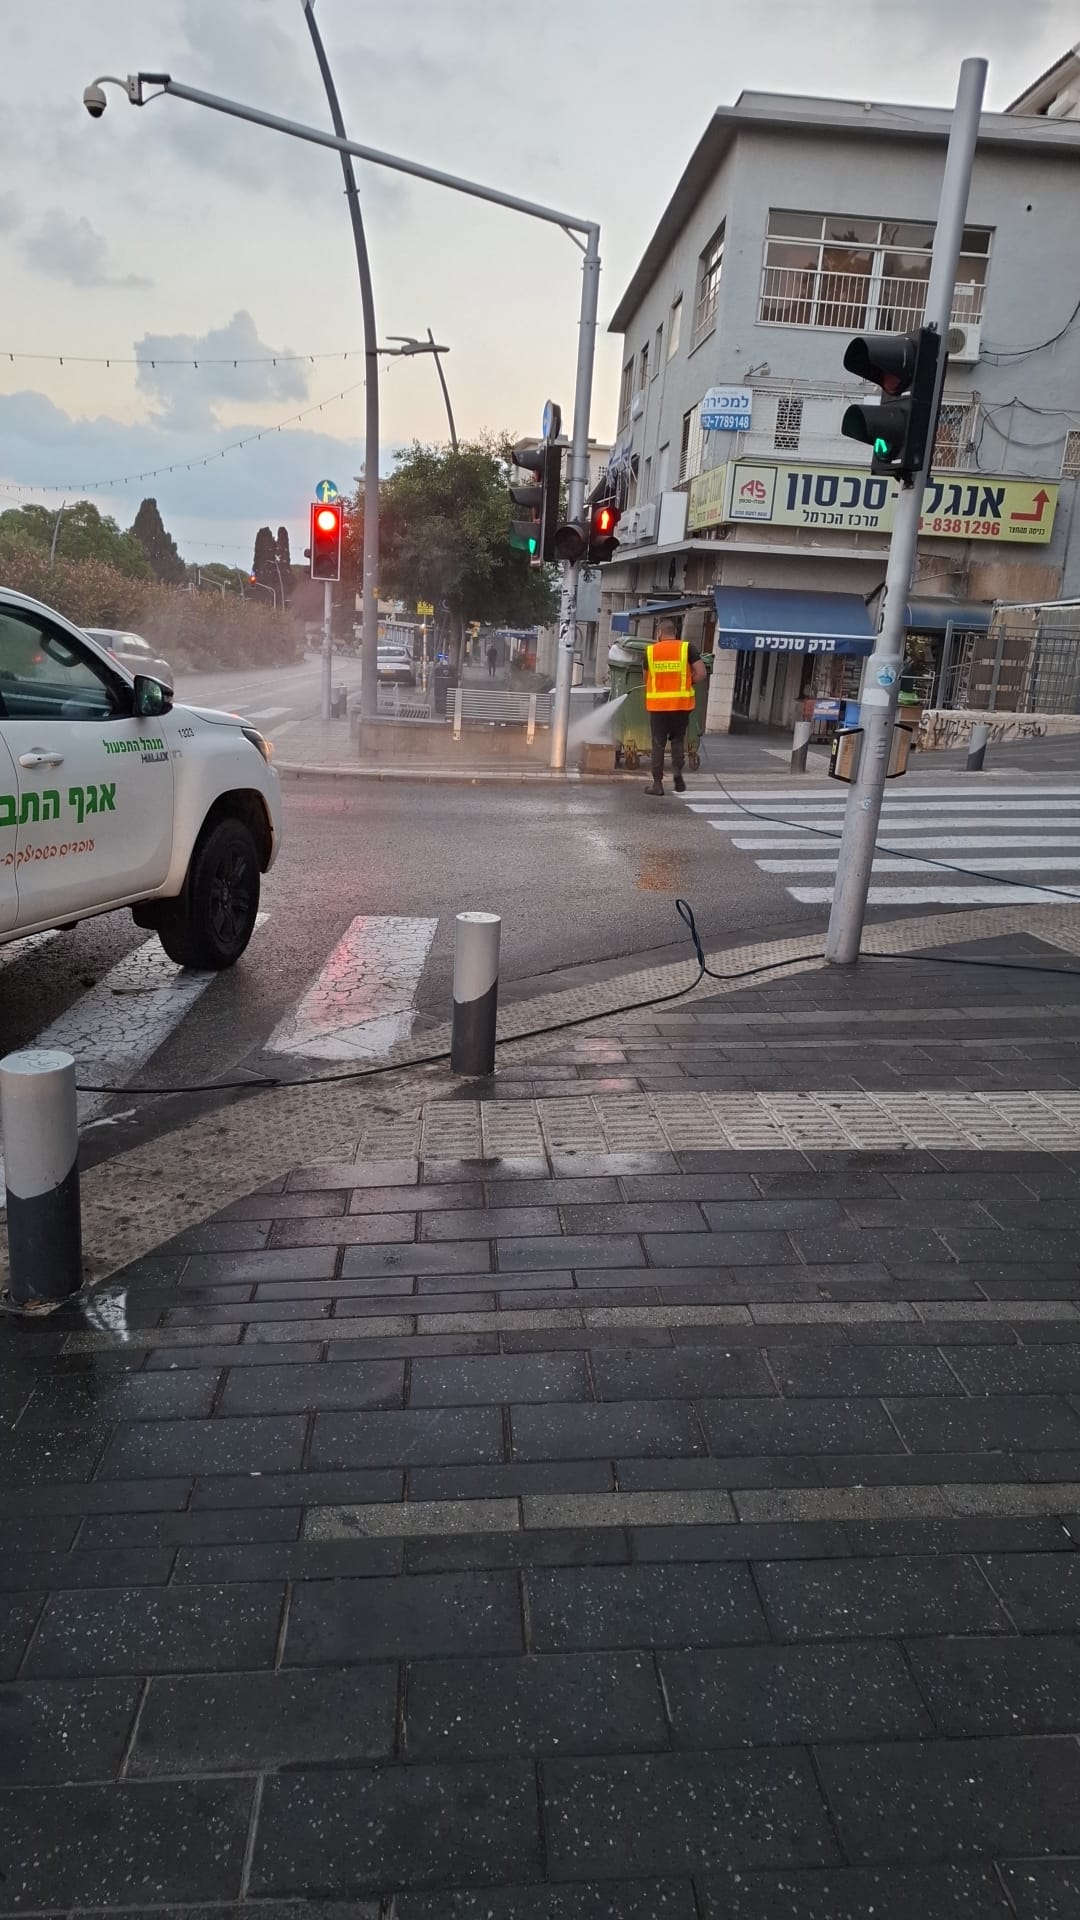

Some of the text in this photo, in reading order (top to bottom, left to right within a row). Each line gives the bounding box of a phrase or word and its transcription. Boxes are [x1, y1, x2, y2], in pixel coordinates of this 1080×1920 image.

[703, 396, 750, 408] למכירה
[741, 480, 766, 499] AS
[787, 473, 1006, 519] אנגל-סכסון
[803, 509, 879, 527] מרכז הכרמל
[1028, 527, 1045, 535] כניסה
[754, 636, 836, 653] ברק סוככים
[103, 737, 164, 754] מנהל התפעול
[69, 783, 116, 824] אגף
[59, 840, 95, 856] עובדים
